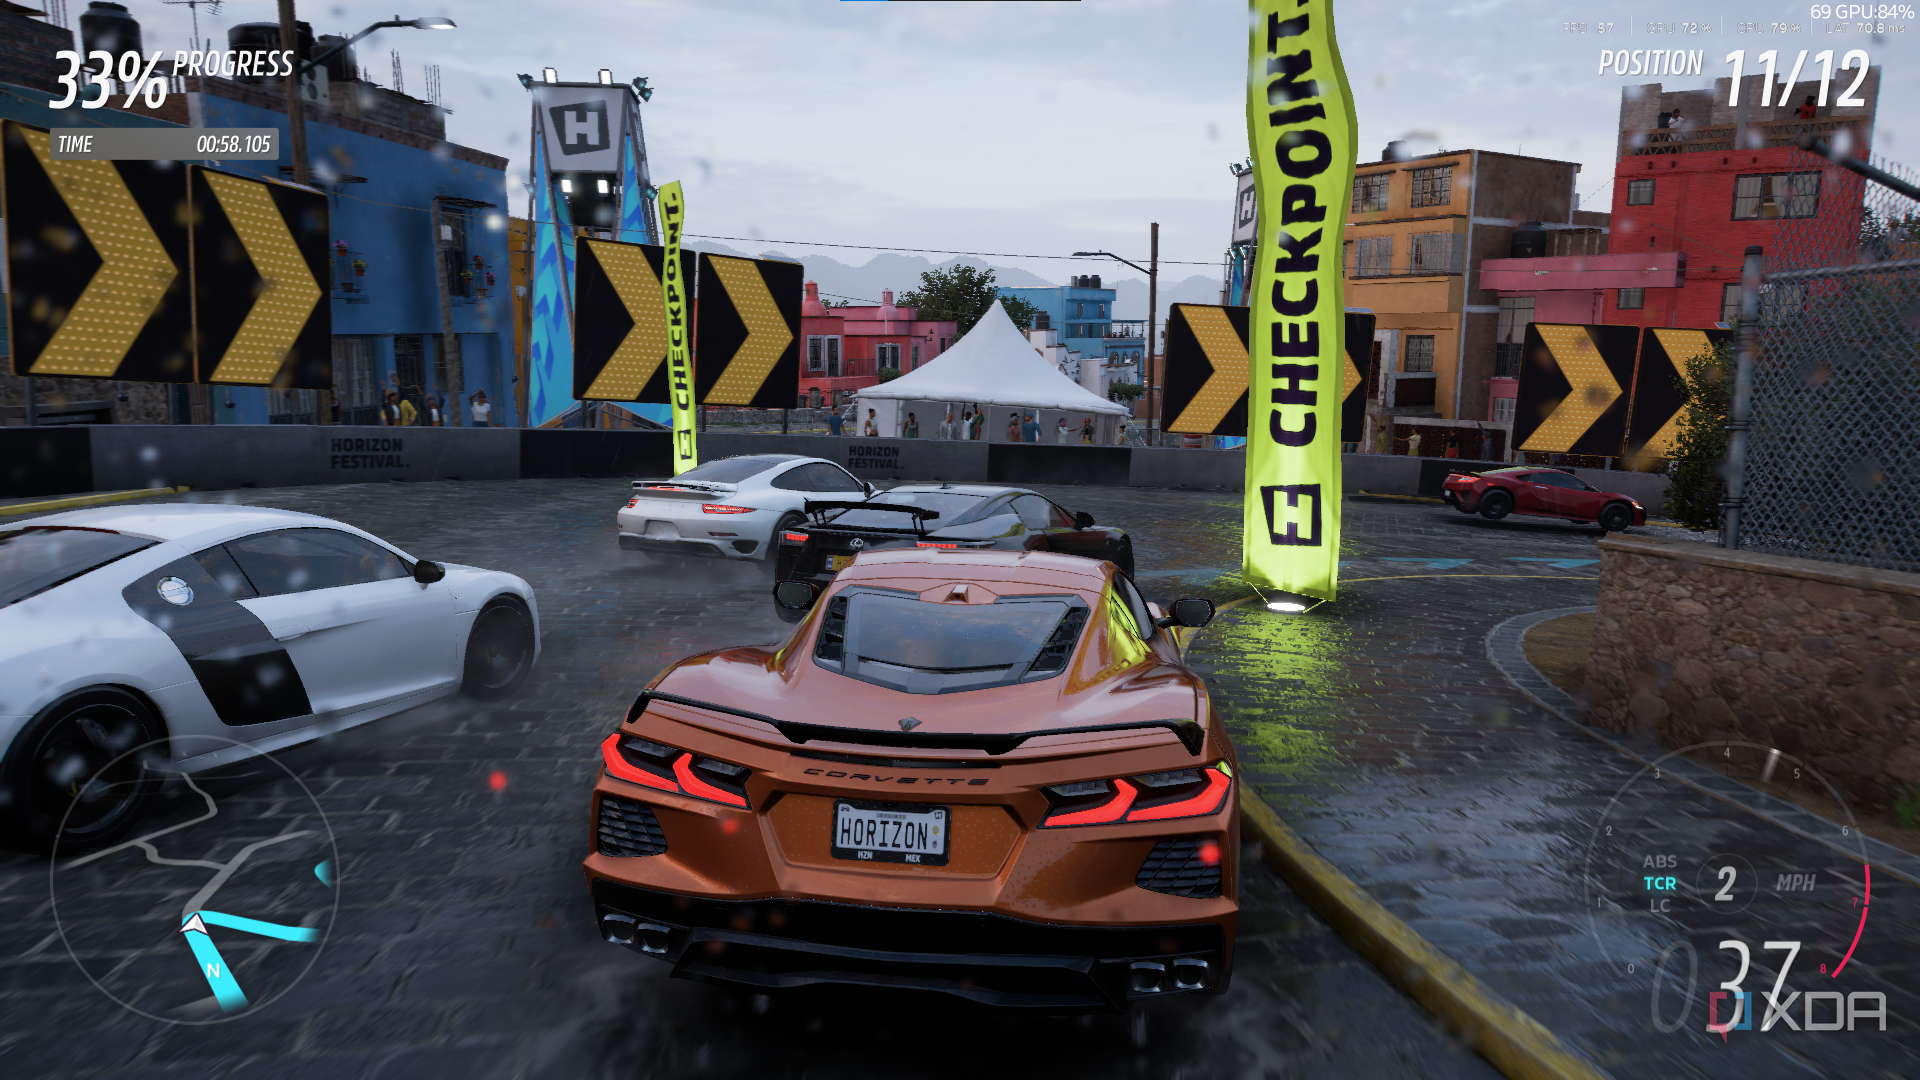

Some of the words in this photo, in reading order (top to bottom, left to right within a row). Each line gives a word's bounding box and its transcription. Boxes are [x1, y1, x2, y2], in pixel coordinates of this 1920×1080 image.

[331, 438, 403, 453] HORIZON
[849, 445, 900, 457] HORIZON
[803, 768, 989, 785] CORVETTE
[840, 817, 928, 850] HORIZON
[857, 850, 874, 860] HZN
[905, 853, 921, 863] MEX
